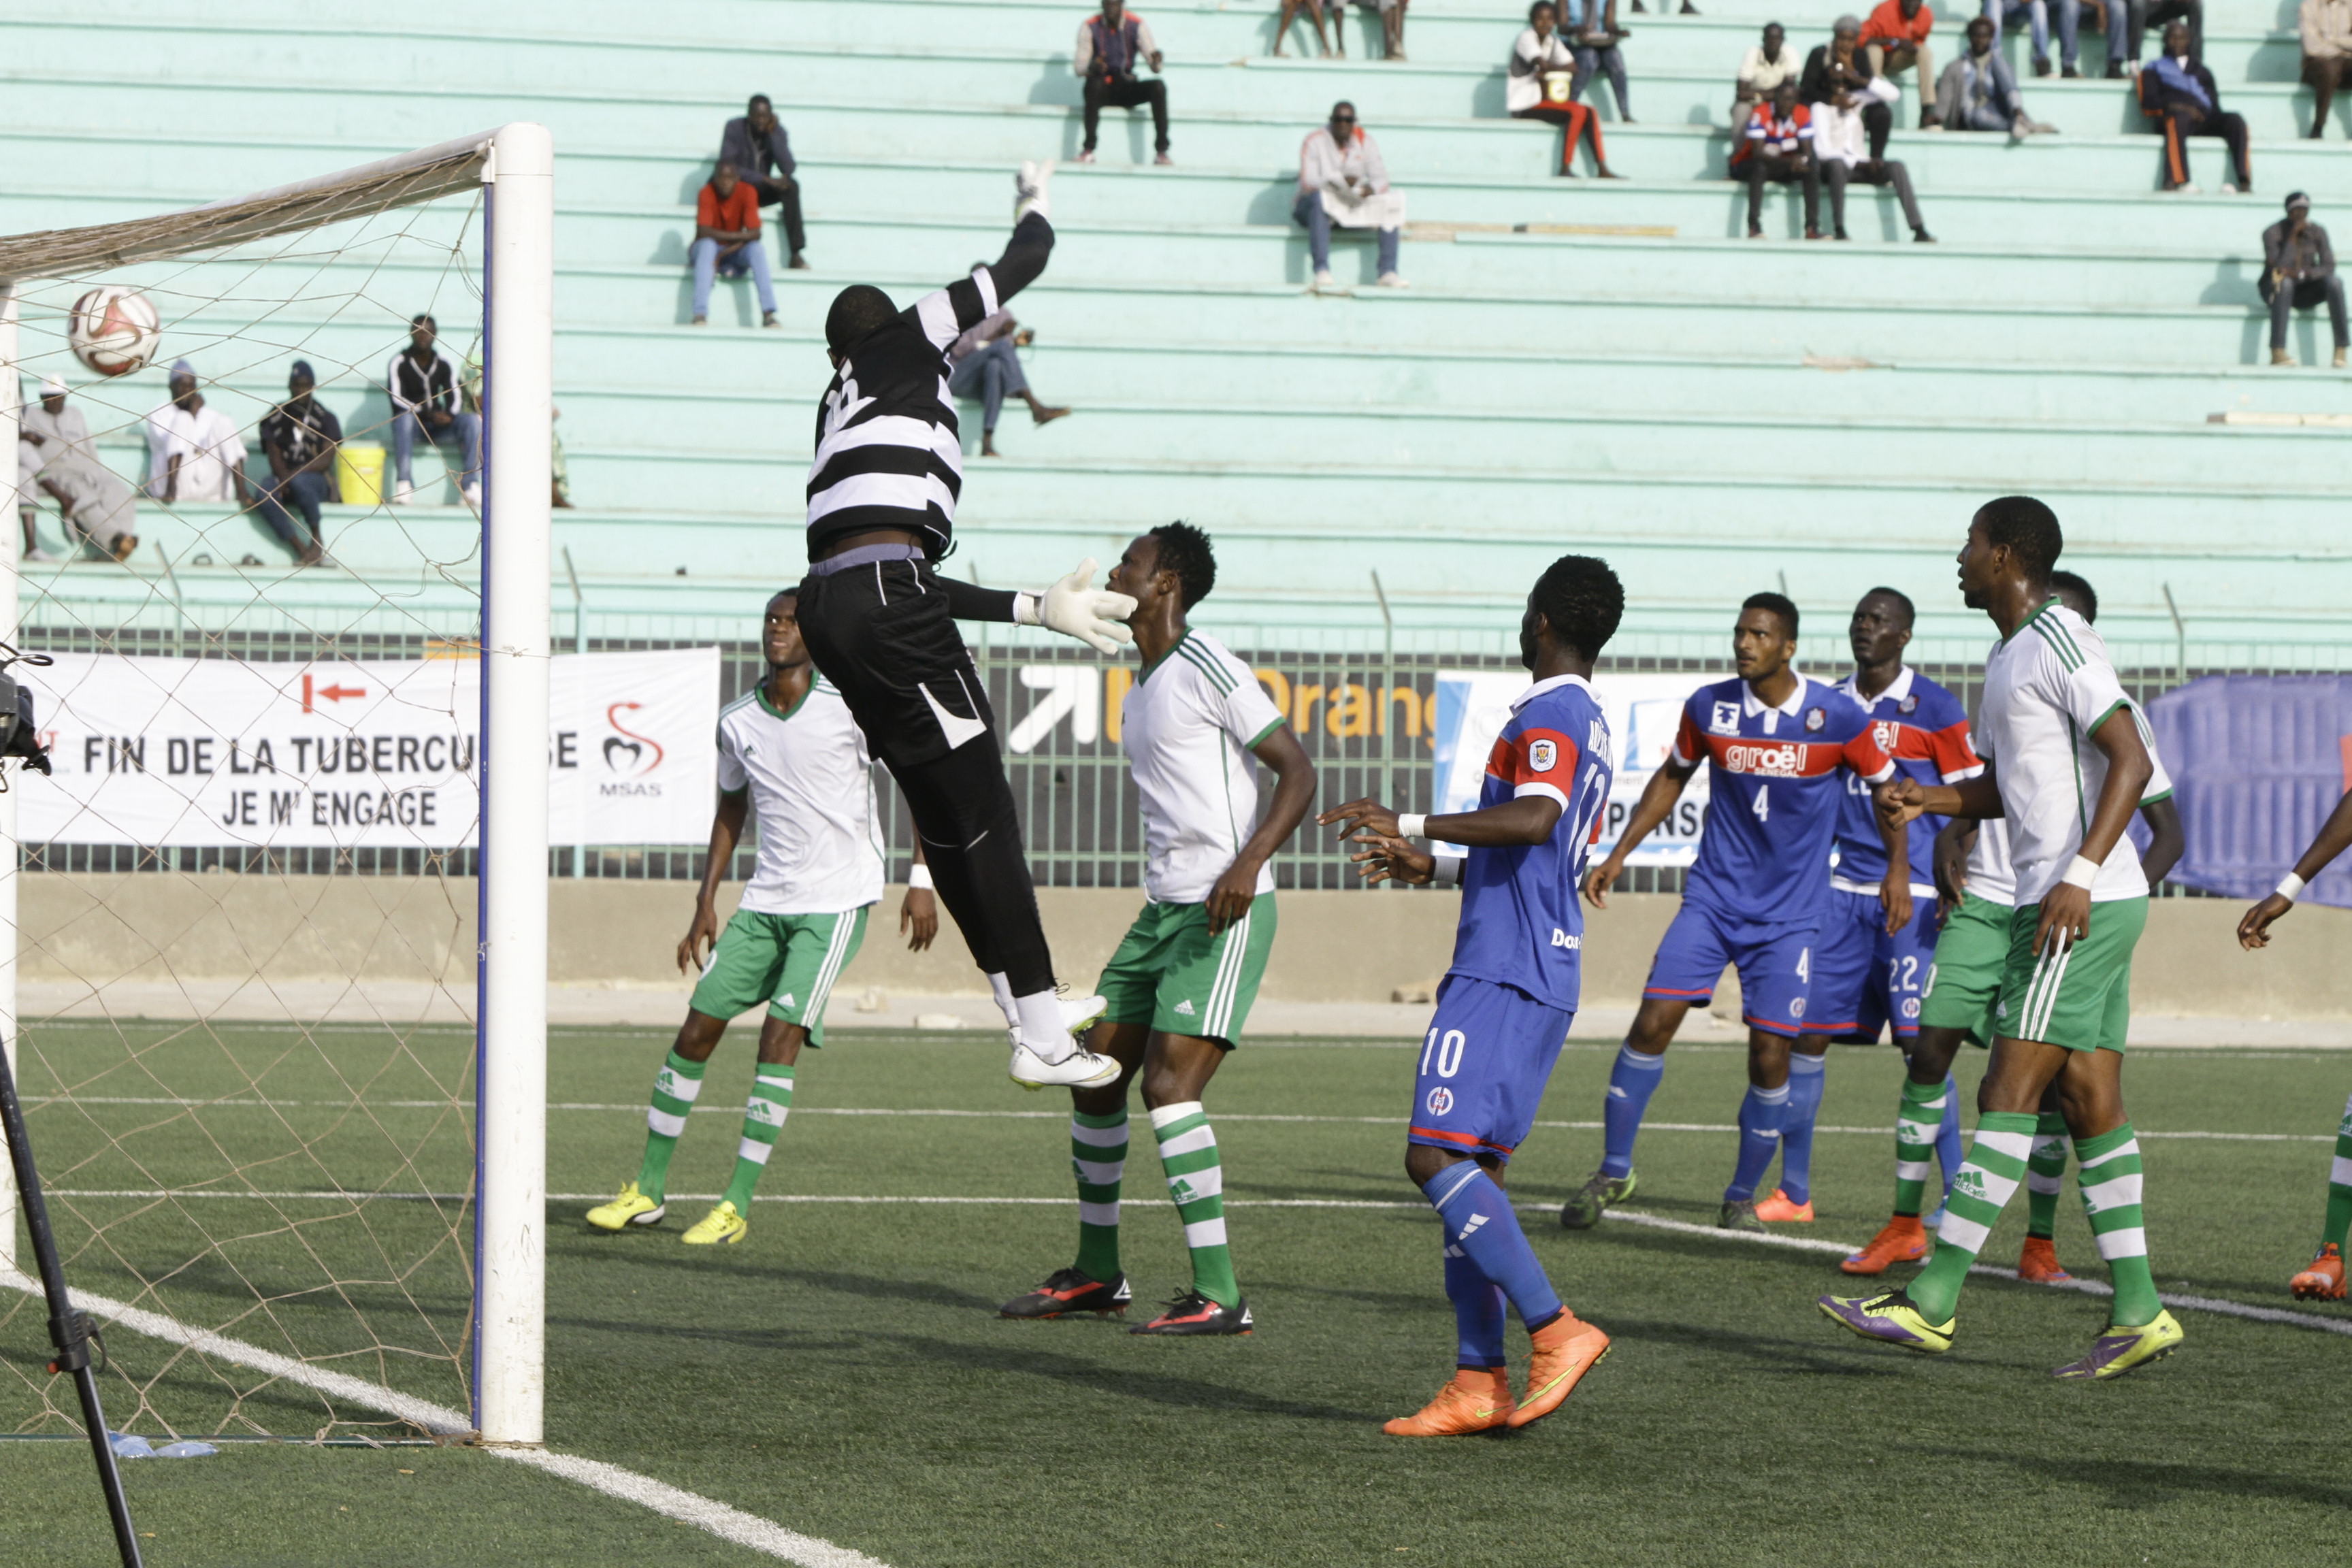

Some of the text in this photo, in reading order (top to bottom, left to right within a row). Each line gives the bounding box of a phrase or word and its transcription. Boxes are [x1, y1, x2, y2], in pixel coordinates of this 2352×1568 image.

[84, 736, 146, 774] FIN
[167, 738, 213, 775] DE
[230, 738, 276, 774] LA
[291, 731, 578, 774] TUBERCUE
[1726, 743, 1808, 774] groël
[600, 782, 662, 798] MSAS
[1752, 784, 1769, 822] 4
[223, 791, 257, 826] JE
[312, 791, 436, 827] ENGAGE
[1796, 947, 1809, 984] 4
[1889, 955, 1918, 992] 22
[1421, 1027, 1465, 1078] 10
